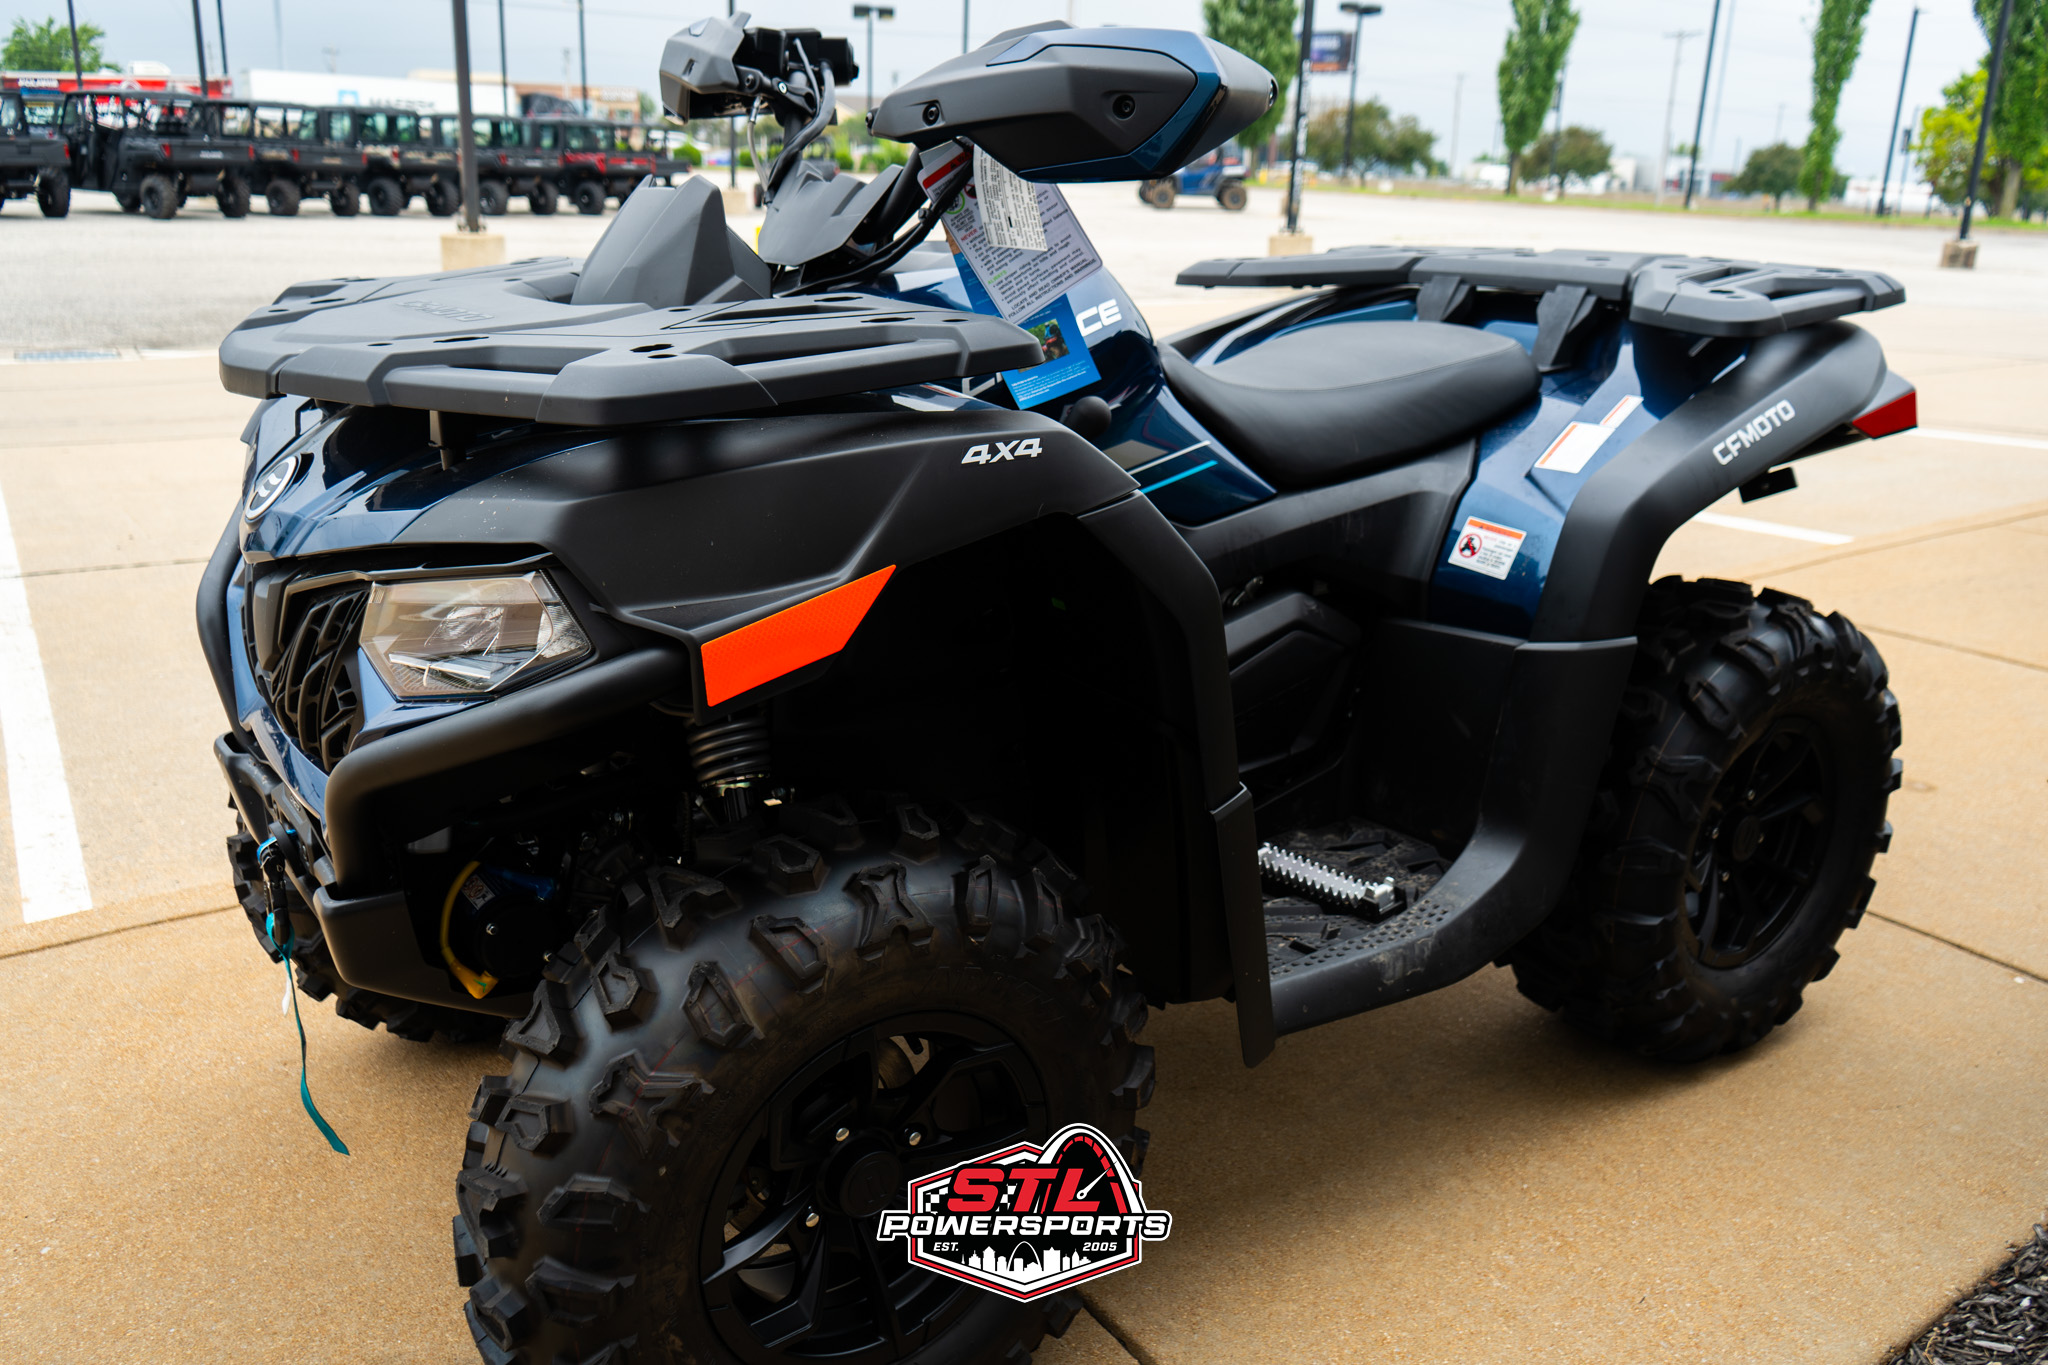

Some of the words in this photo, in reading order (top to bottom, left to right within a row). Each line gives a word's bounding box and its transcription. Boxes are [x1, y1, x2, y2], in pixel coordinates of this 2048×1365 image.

[960, 228, 978, 242] NEVER
[1713, 399, 1795, 465] CFMOTO
[961, 438, 1042, 465] 4X4
